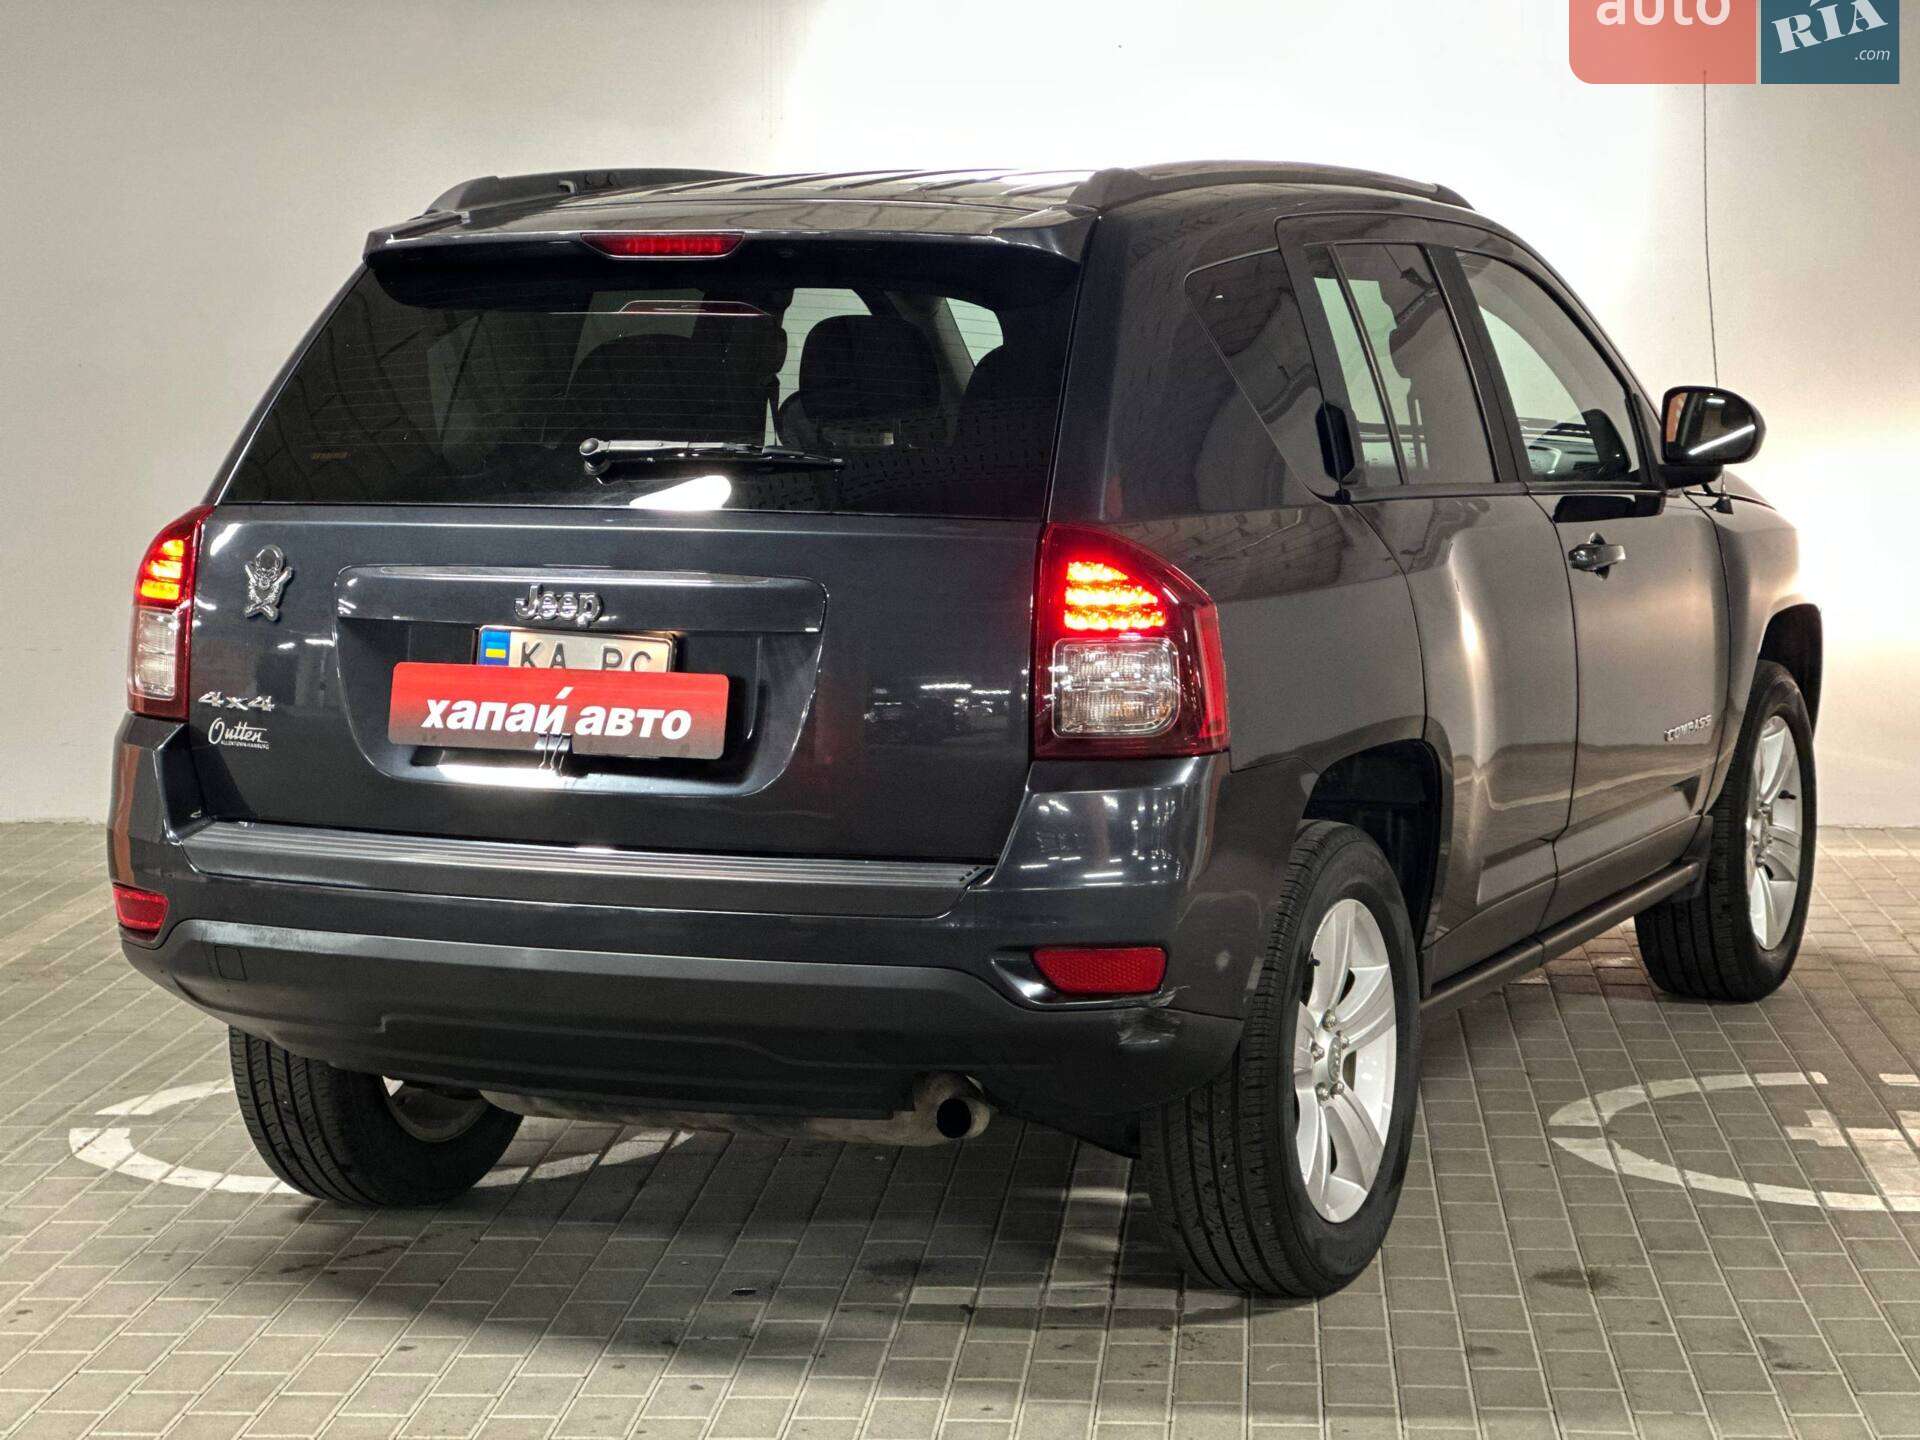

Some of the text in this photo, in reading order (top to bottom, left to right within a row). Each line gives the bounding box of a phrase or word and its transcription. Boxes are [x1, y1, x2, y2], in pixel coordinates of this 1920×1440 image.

[514, 583, 602, 627] Jeep
[575, 706, 692, 740] авто
[1664, 714, 1712, 741] COMPASS
